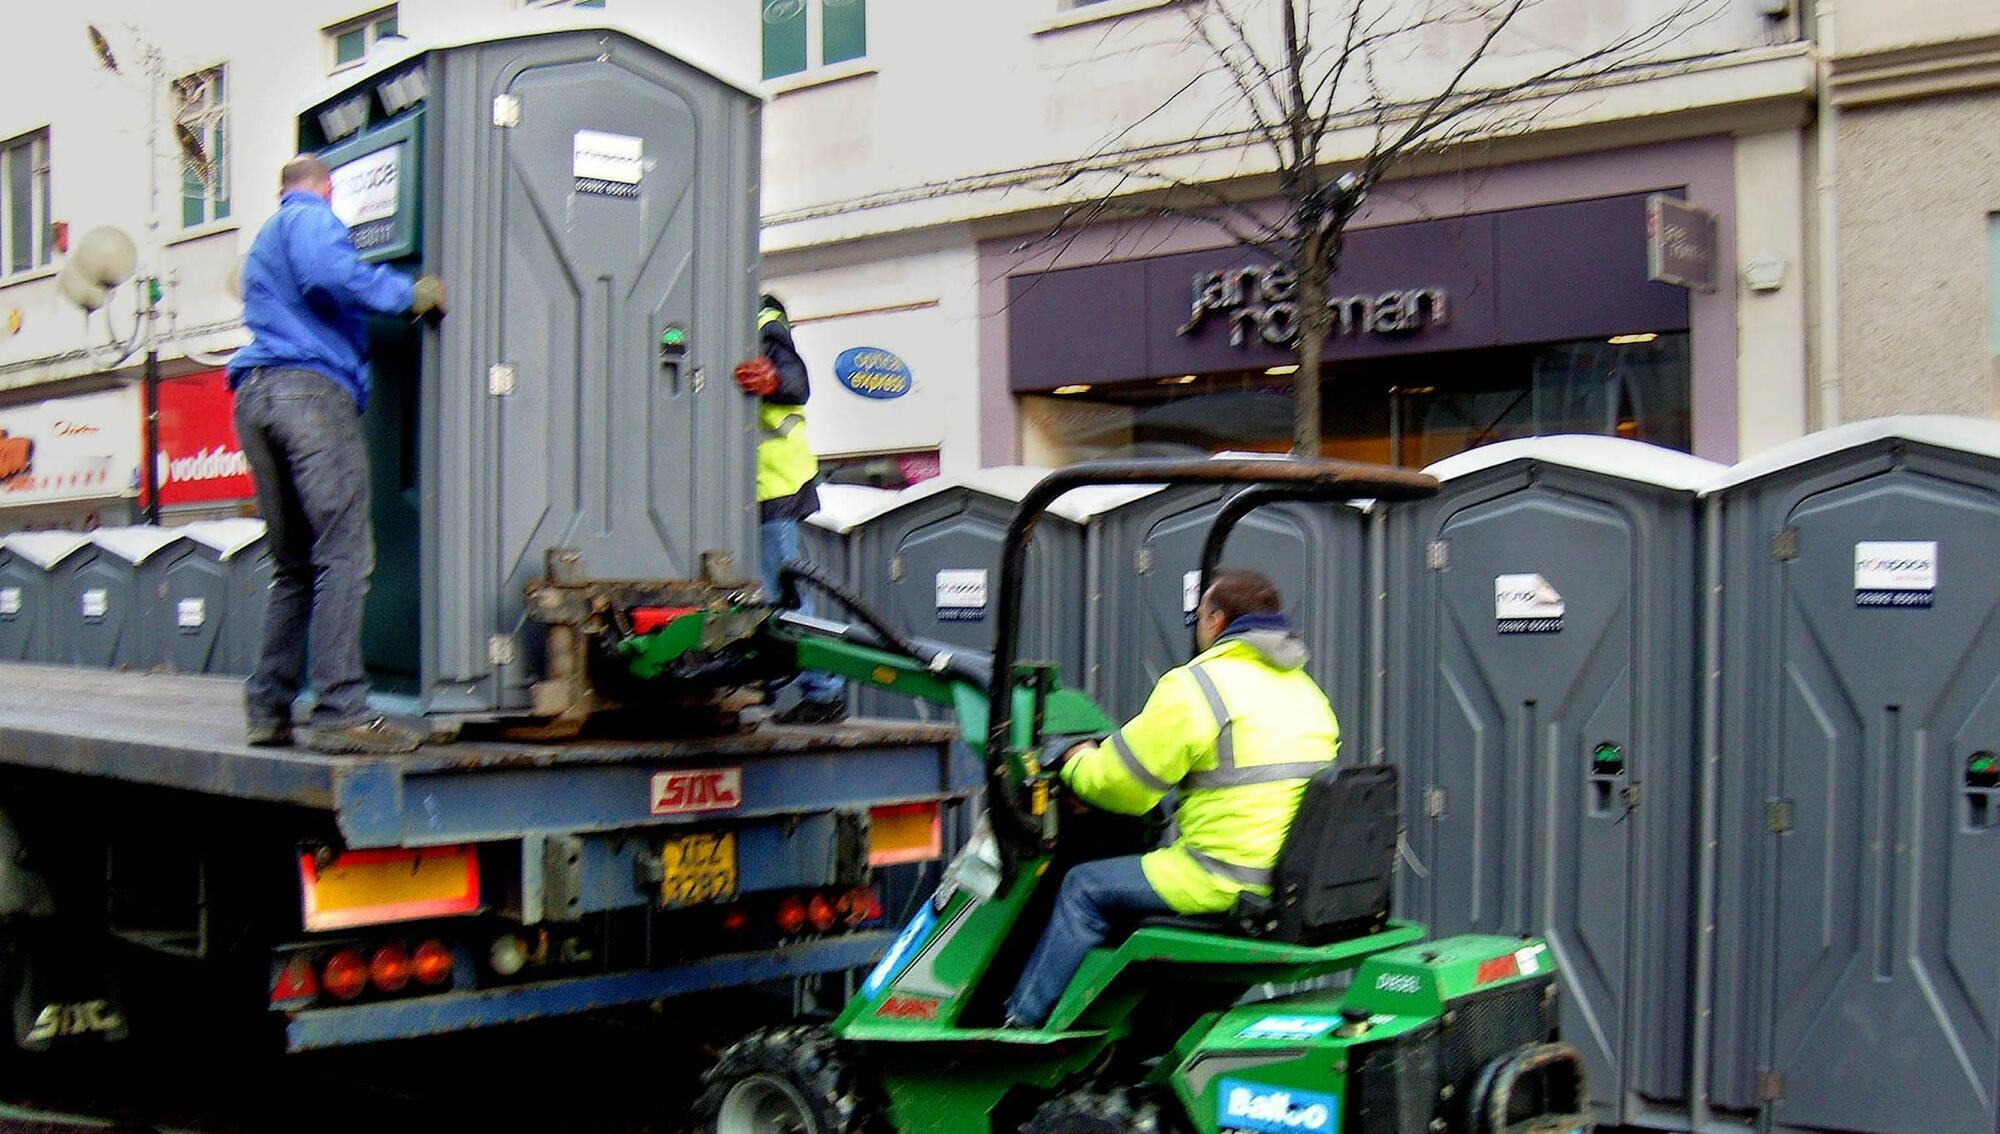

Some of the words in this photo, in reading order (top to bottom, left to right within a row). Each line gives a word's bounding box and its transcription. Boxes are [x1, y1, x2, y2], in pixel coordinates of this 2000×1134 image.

[1176, 261, 1300, 336] jane
[1229, 288, 1447, 347] noman
[854, 351, 904, 369] optical
[850, 371, 906, 393] express
